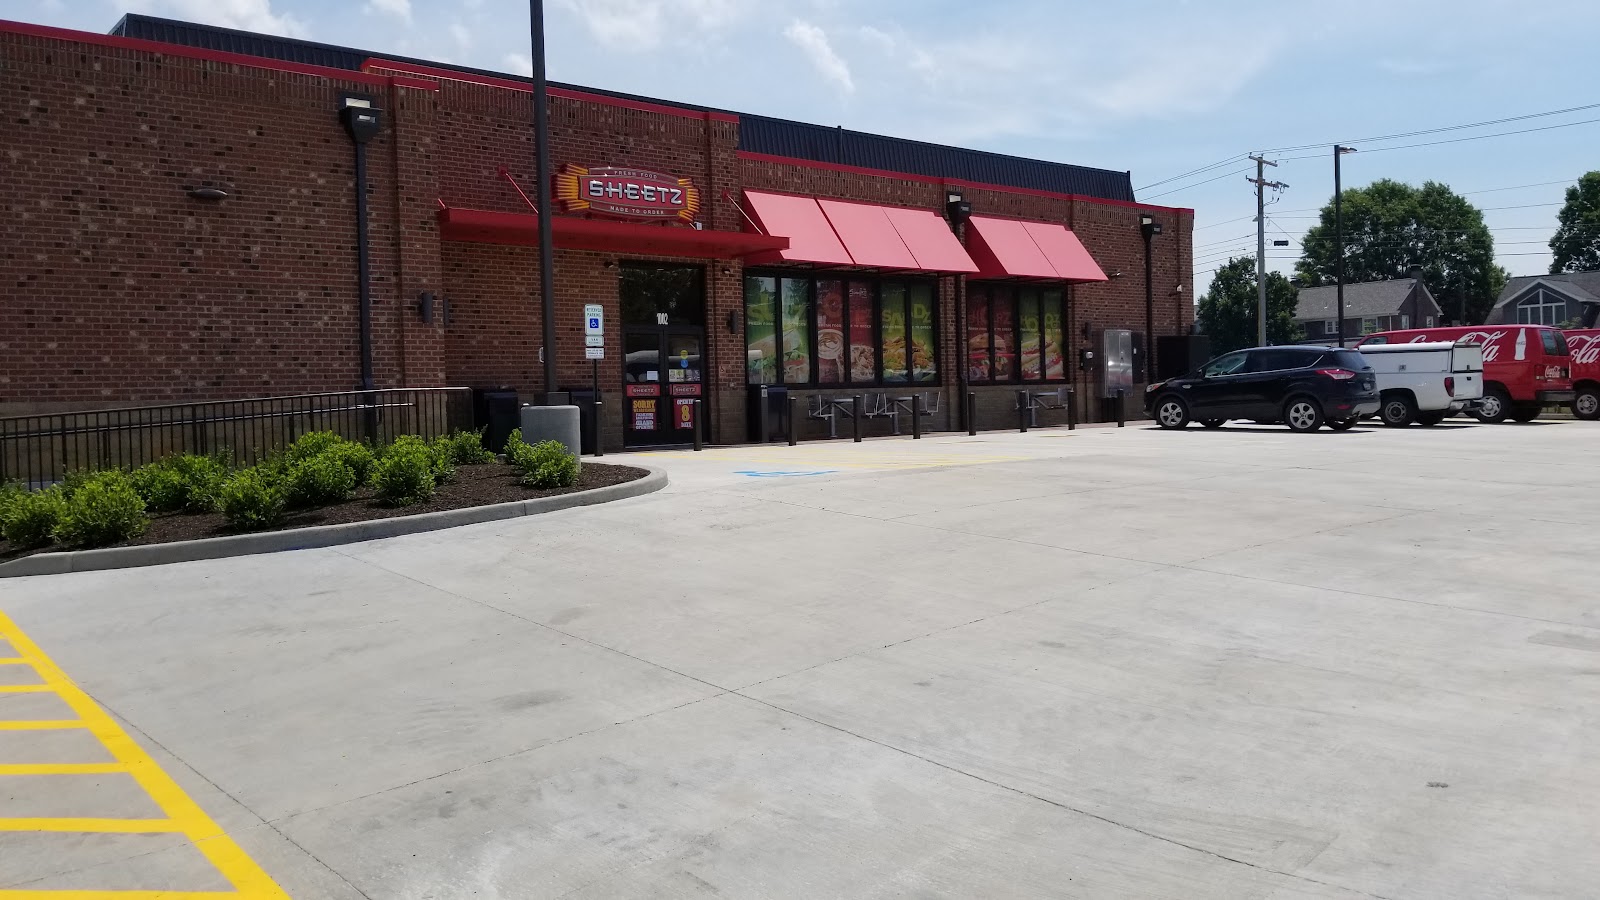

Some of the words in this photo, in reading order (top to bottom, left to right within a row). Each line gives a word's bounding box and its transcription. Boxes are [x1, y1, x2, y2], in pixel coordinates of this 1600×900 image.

[614, 170, 637, 178] FRESH
[588, 179, 683, 205] SHEETZ
[610, 205, 629, 213] MADE
[643, 208, 664, 216] ORDER
[656, 312, 669, 325] 1002
[633, 399, 656, 409] SORRY
[681, 404, 690, 422] 8
